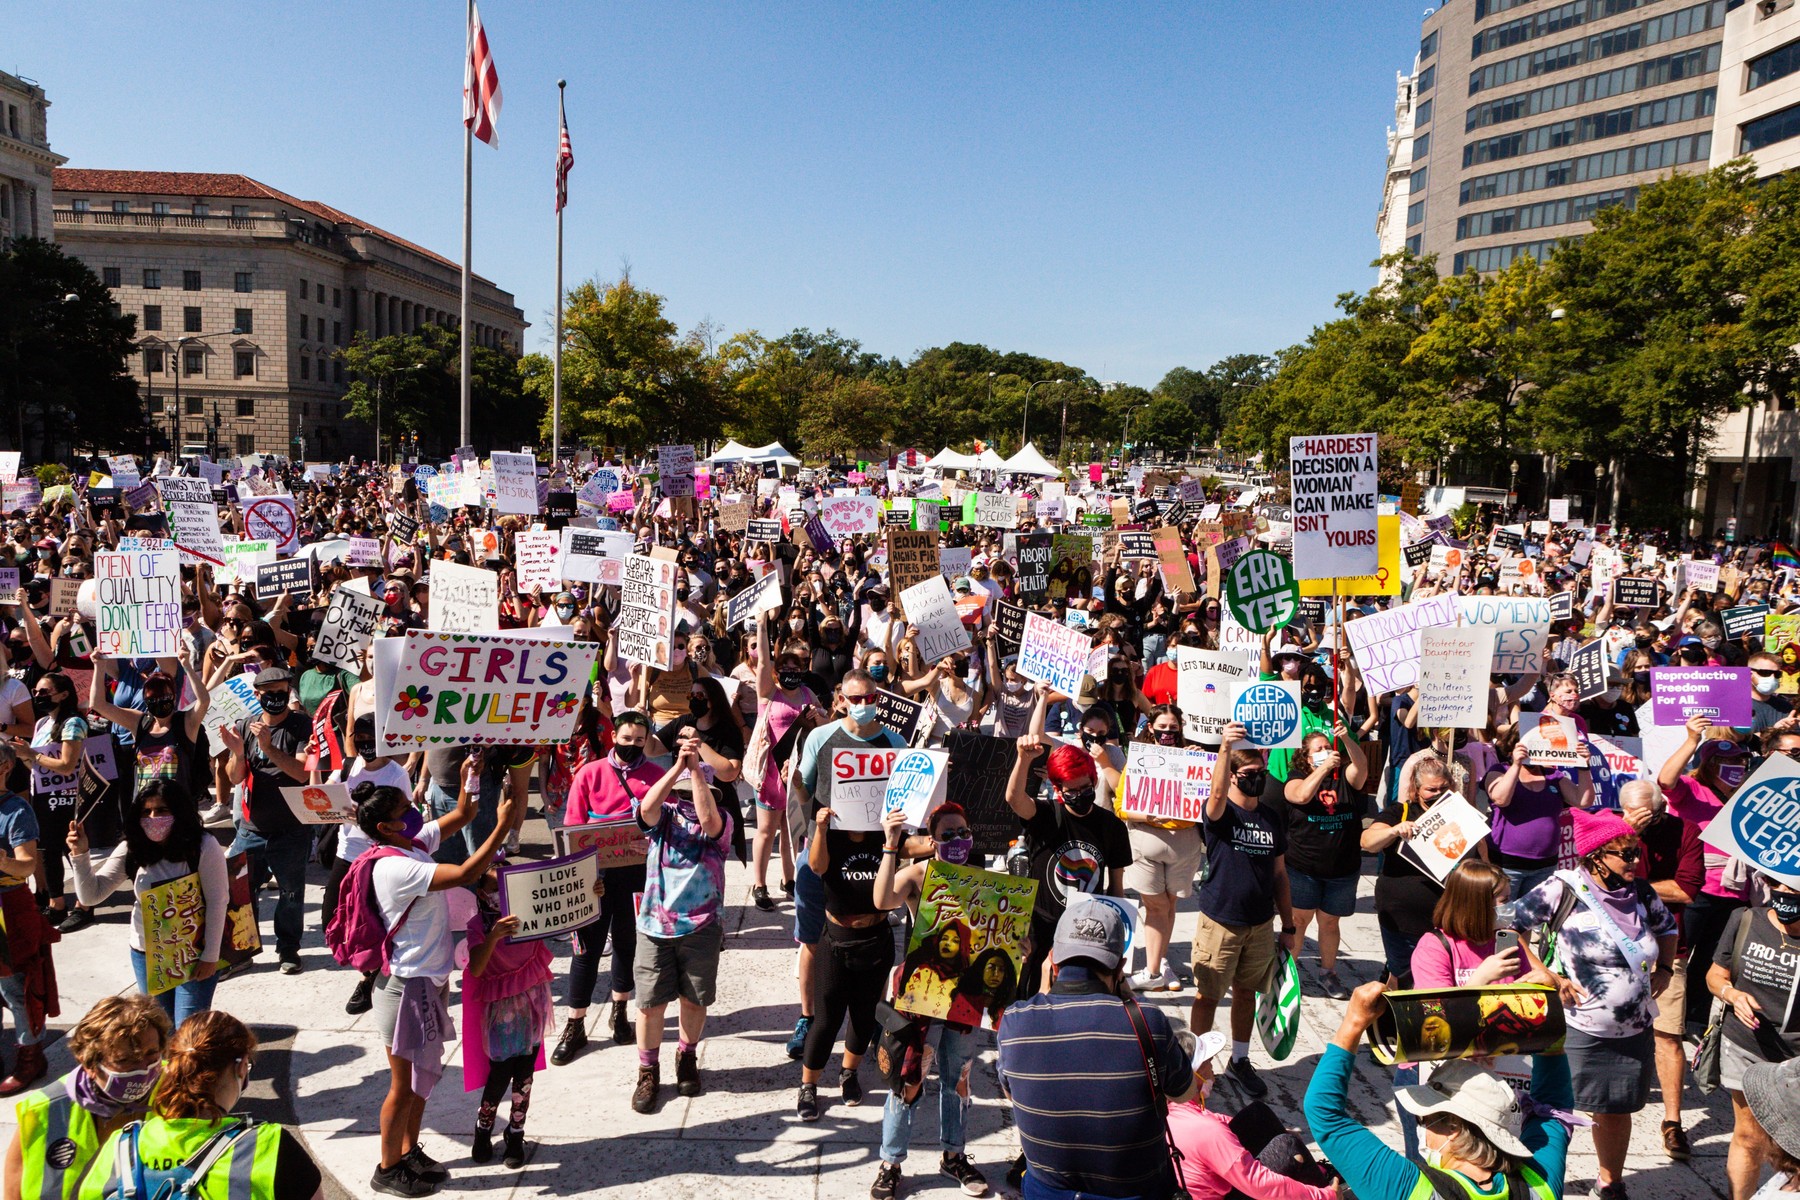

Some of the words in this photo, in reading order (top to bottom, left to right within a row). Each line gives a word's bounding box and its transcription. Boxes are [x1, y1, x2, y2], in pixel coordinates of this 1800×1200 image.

[1292, 441, 1306, 453] THE
[1305, 437, 1373, 456] HARDEST
[1293, 457, 1359, 476] DECISION
[1363, 456, 1374, 472] A
[163, 479, 188, 491] THINGS
[189, 481, 206, 491] THAT
[500, 475, 523, 485] MAKE
[162, 490, 184, 500] REDUCE
[185, 491, 213, 503] ABORTION
[500, 487, 535, 500] HISTORY
[831, 500, 865, 515] PUSSY
[917, 502, 939, 514] MIND
[984, 495, 1010, 508] STARE
[1294, 496, 1325, 513] CAN
[1331, 493, 1374, 511] MAKE
[919, 515, 939, 525] YOUR
[978, 510, 1012, 522] DECISIS
[1294, 515, 1329, 532] ISN'T
[830, 518, 866, 532] POWER
[123, 538, 138, 546] it's
[141, 539, 162, 547] 2021
[894, 535, 935, 549] EQUAL
[1325, 530, 1376, 547] YOURS
[893, 551, 917, 562] RIGHTS
[1407, 545, 1420, 553] KEEP
[1410, 551, 1424, 559] LAWS
[96, 555, 131, 578] MEN
[139, 553, 164, 576] OF
[260, 566, 276, 574] YOUR
[280, 562, 307, 571] REASON
[625, 556, 654, 572] LGBTQ+
[894, 563, 919, 574] OTHERS
[1035, 563, 1044, 573] IS
[1693, 565, 1717, 574] FUTURE
[282, 572, 294, 580] THE
[626, 569, 654, 583] RIGHTS
[896, 575, 910, 584] NOT
[1234, 552, 1286, 599] ERA
[99, 575, 177, 605] QUALITY
[259, 584, 278, 593] RIGHT
[282, 580, 308, 590] REASON
[624, 581, 637, 591] SEX
[638, 584, 648, 593] ED
[907, 584, 929, 599] LIVE
[338, 590, 381, 622] Think
[623, 590, 642, 604] BIRTH
[642, 595, 658, 608] CTRL
[906, 594, 945, 613] LAUGH
[101, 603, 141, 631] DON'T
[145, 603, 181, 630] FEAR
[621, 605, 650, 621] FOSTER/
[916, 608, 945, 625] LEAVE
[1003, 607, 1021, 618] KEEP
[1237, 590, 1294, 631] YES
[327, 605, 375, 637] Outside
[620, 616, 640, 631] ADOPT
[642, 621, 657, 636] KIDS
[929, 620, 943, 630] US
[1003, 618, 1023, 629] LAWS
[1348, 593, 1460, 649] REPRODUCTIVE
[620, 632, 650, 647] CONTROL
[1003, 628, 1013, 636] MY
[1029, 615, 1074, 641] RESPECT
[1076, 636, 1090, 650] MY
[99, 629, 178, 655] EQUALITY
[924, 627, 968, 659] ALONE
[1027, 631, 1069, 659] EXISTANCE
[1072, 649, 1087, 667] OR
[1425, 638, 1456, 648] Protect
[319, 635, 364, 669] BOX
[620, 643, 651, 662] WOMEN
[1024, 644, 1070, 672] EXPECT
[1424, 648, 1472, 662] Daughters
[1581, 653, 1589, 666] OFF
[419, 646, 568, 686] GIRLS
[1591, 650, 1599, 670] BODY
[1021, 658, 1074, 693] RESISTANCE
[1180, 660, 1198, 671] LET'S
[1200, 660, 1215, 670] TALK
[1217, 663, 1243, 676] ABOUT
[1581, 667, 1591, 690] LAWS
[1592, 673, 1601, 684] MY
[1655, 670, 1738, 682] Reproductive
[1245, 686, 1285, 704] KEEP
[1656, 683, 1710, 693] Freedom
[213, 692, 243, 720] SAFE
[1421, 693, 1473, 704] Reproductive
[1657, 696, 1676, 704] For
[1679, 695, 1698, 704] All.
[434, 690, 549, 731] RULE!
[891, 698, 914, 716] YOUR
[1236, 703, 1296, 721] ABORTION
[1421, 704, 1466, 713] Healthcare
[891, 713, 909, 725] OFF
[1188, 714, 1200, 723] THE
[1423, 711, 1459, 723] Rights!
[1192, 724, 1198, 732] IN
[1200, 725, 1213, 734] THE
[1149, 746, 1167, 755] YOU
[1529, 749, 1543, 758] MY
[1545, 750, 1578, 759] POWER
[833, 751, 896, 779] STOP
[899, 752, 931, 770] KEEP
[888, 771, 933, 795] ABORTION
[834, 786, 862, 800] WAR
[1126, 775, 1182, 818] WOMAN
[1308, 812, 1353, 822] REPRODUCTIVE
[1320, 822, 1343, 830] RIGHTS
[1421, 818, 1446, 842] BODY
[1232, 826, 1274, 845] WARREN
[1234, 846, 1271, 856] DEMOCRAT
[539, 873, 544, 884] I
[550, 866, 577, 882] LOVE
[531, 878, 585, 900] SOMEONE
[532, 900, 561, 915] WHO
[567, 893, 586, 908] HAD
[926, 884, 960, 904] Come
[967, 889, 987, 912] for
[522, 920, 538, 932] AN
[544, 903, 594, 929] ABORTION
[921, 902, 965, 935] Face
[968, 910, 987, 930] Us
[166, 952, 186, 984] Come
[1755, 965, 1774, 974] radical
